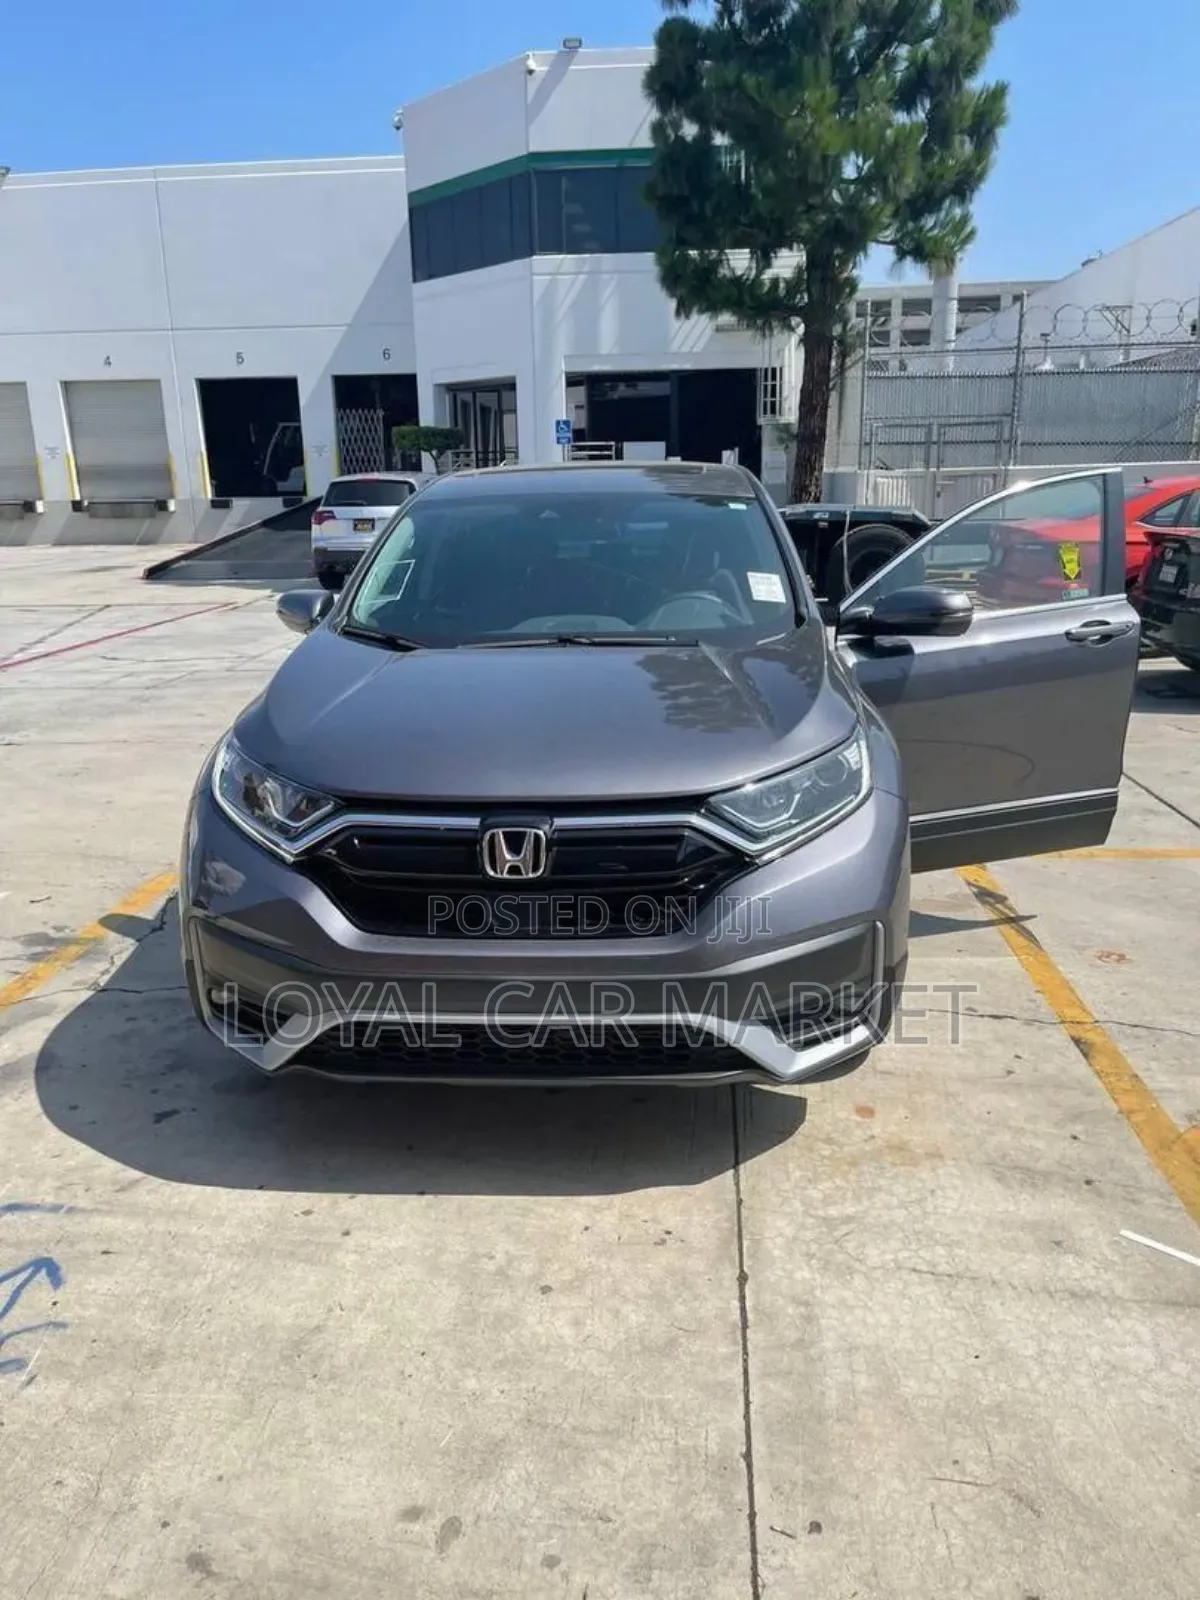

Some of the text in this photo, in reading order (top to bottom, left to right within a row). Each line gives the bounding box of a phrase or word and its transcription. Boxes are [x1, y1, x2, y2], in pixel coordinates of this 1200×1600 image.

[236, 351, 245, 366] 5
[382, 347, 391, 361] 6
[103, 355, 112, 368] 4
